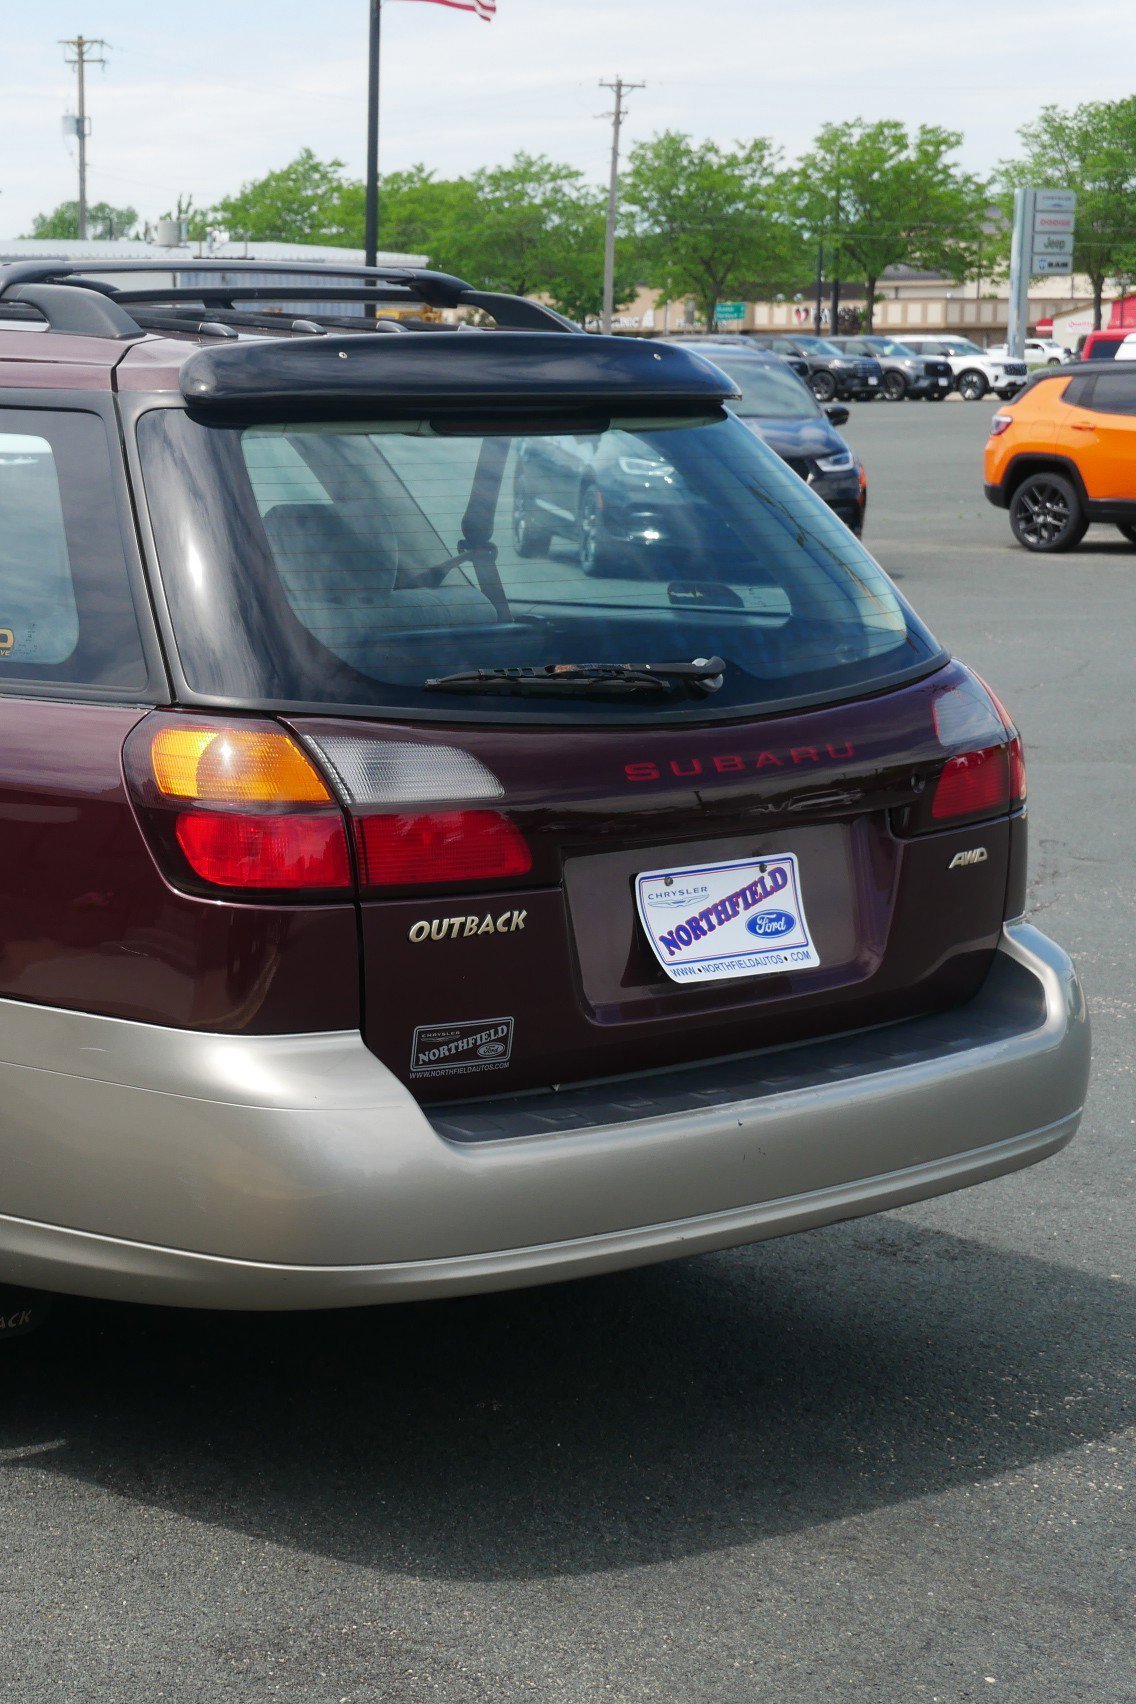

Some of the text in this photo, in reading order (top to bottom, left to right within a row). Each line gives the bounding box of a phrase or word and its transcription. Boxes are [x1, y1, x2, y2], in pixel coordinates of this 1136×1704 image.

[1044, 236, 1066, 250] Jeep
[624, 741, 856, 781] SUBARU
[948, 846, 988, 869] AWD
[648, 886, 708, 900] CHRYSLER
[659, 866, 788, 956] NORTHFIELD
[409, 909, 528, 943] OUTBACK
[755, 913, 787, 934] Ford
[418, 1025, 508, 1064] NORTHFIELD
[483, 1044, 501, 1055] Ford
[409, 1061, 510, 1079] WWW.NORTHFIELDAUTOS.COM
